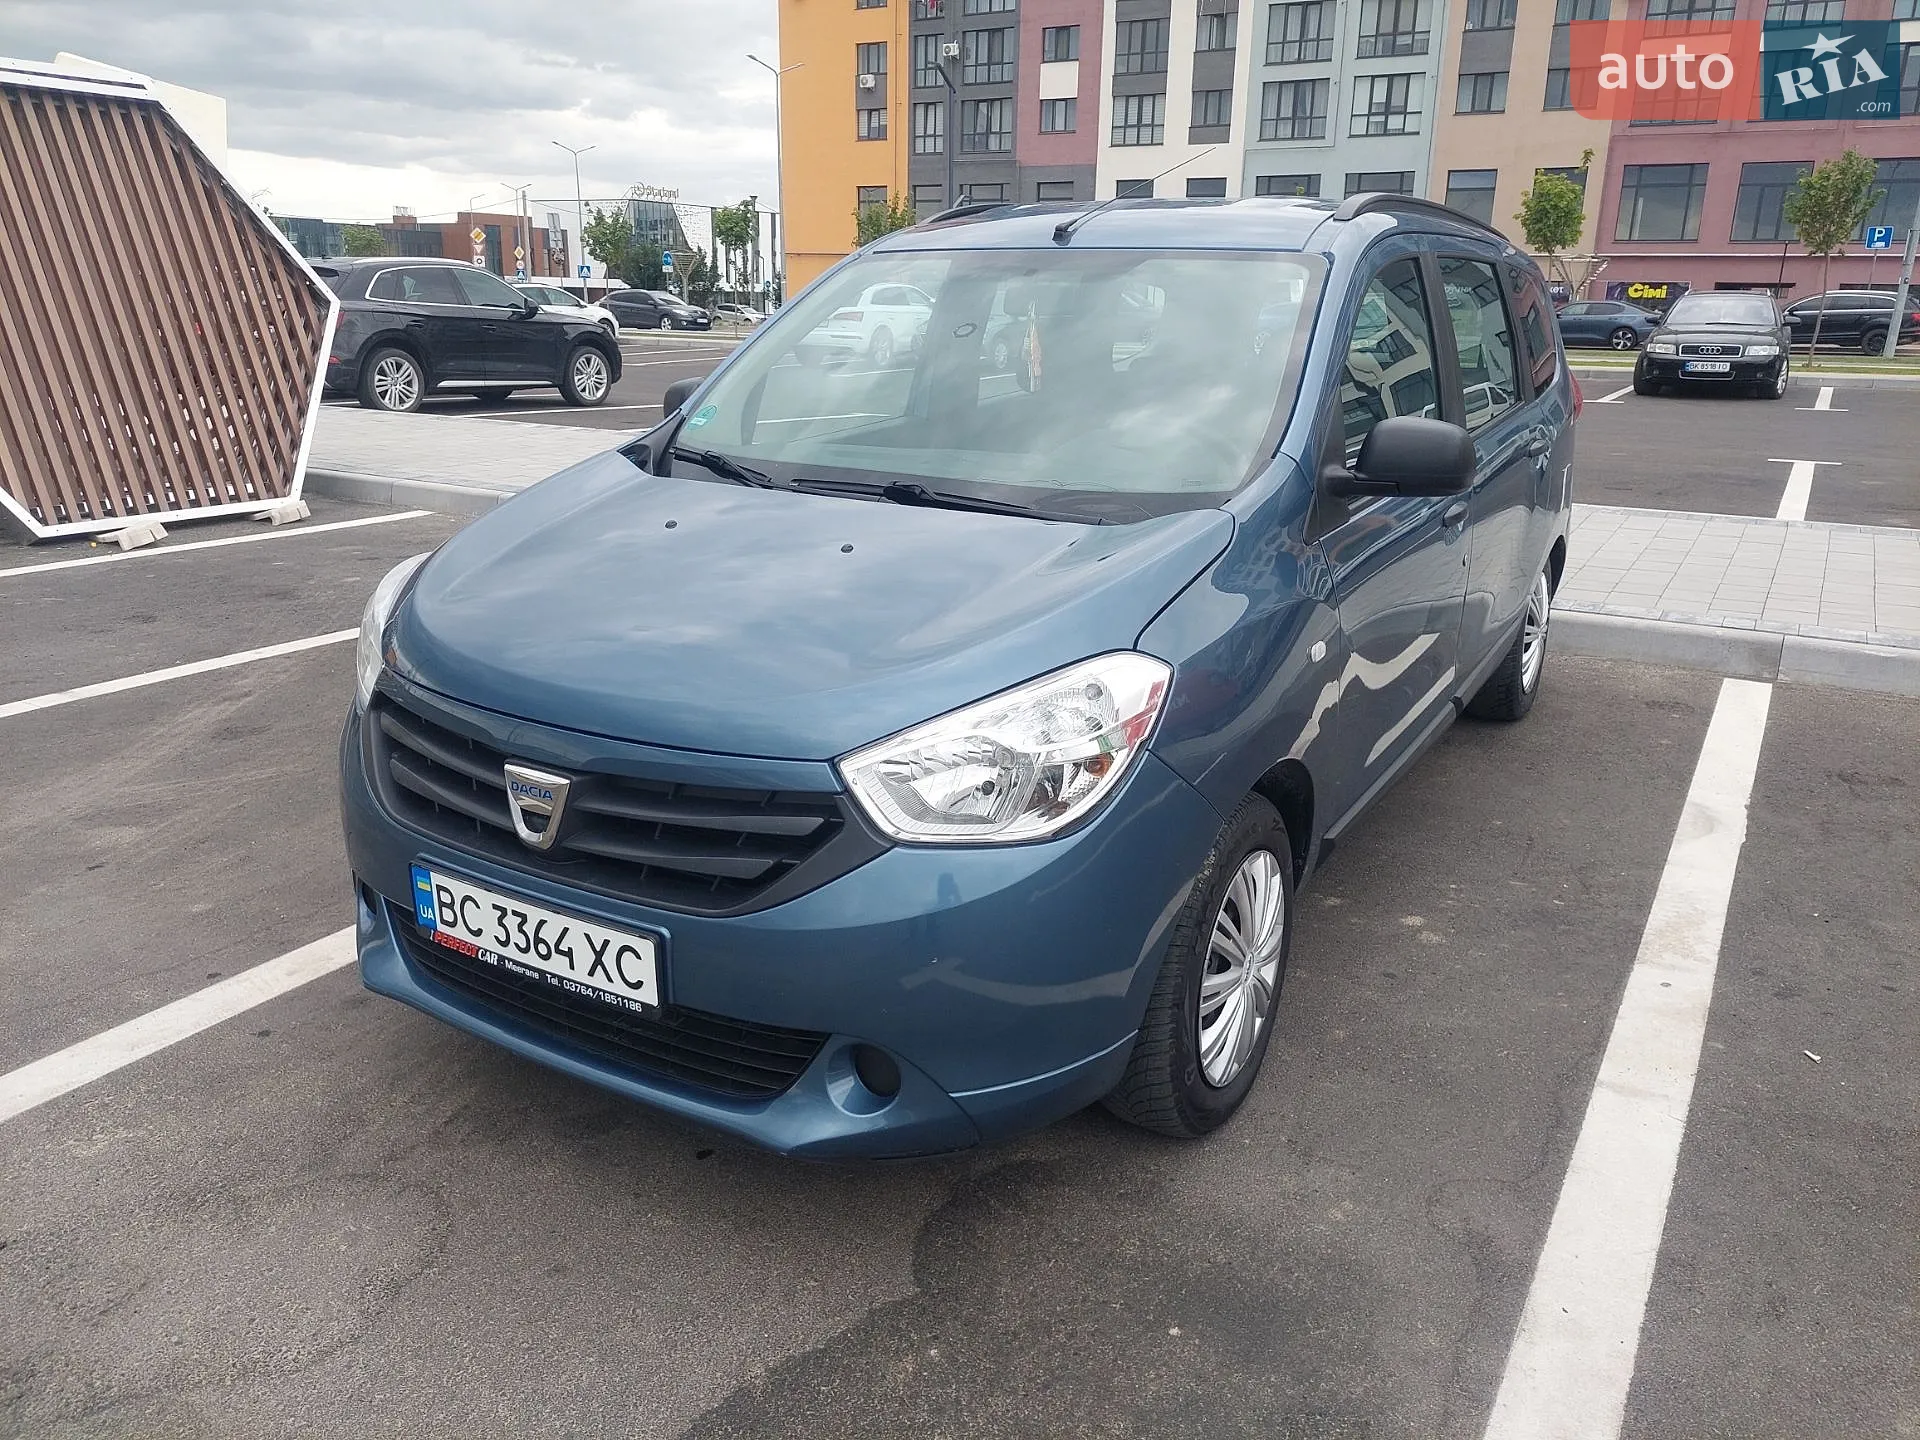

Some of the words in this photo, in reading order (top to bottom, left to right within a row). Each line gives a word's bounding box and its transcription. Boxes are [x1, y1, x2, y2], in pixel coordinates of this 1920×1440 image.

[1874, 228, 1886, 241] P
[511, 781, 553, 801] DACIA
[419, 903, 435, 921] UA
[435, 883, 484, 938] BC
[491, 903, 575, 971] 3364
[583, 932, 645, 990] XC
[433, 930, 479, 958] PERFECT
[478, 948, 499, 966] CAR
[505, 959, 540, 980] Meerane
[545, 973, 561, 987] Tel.
[563, 979, 643, 1013] 03764/1851186
